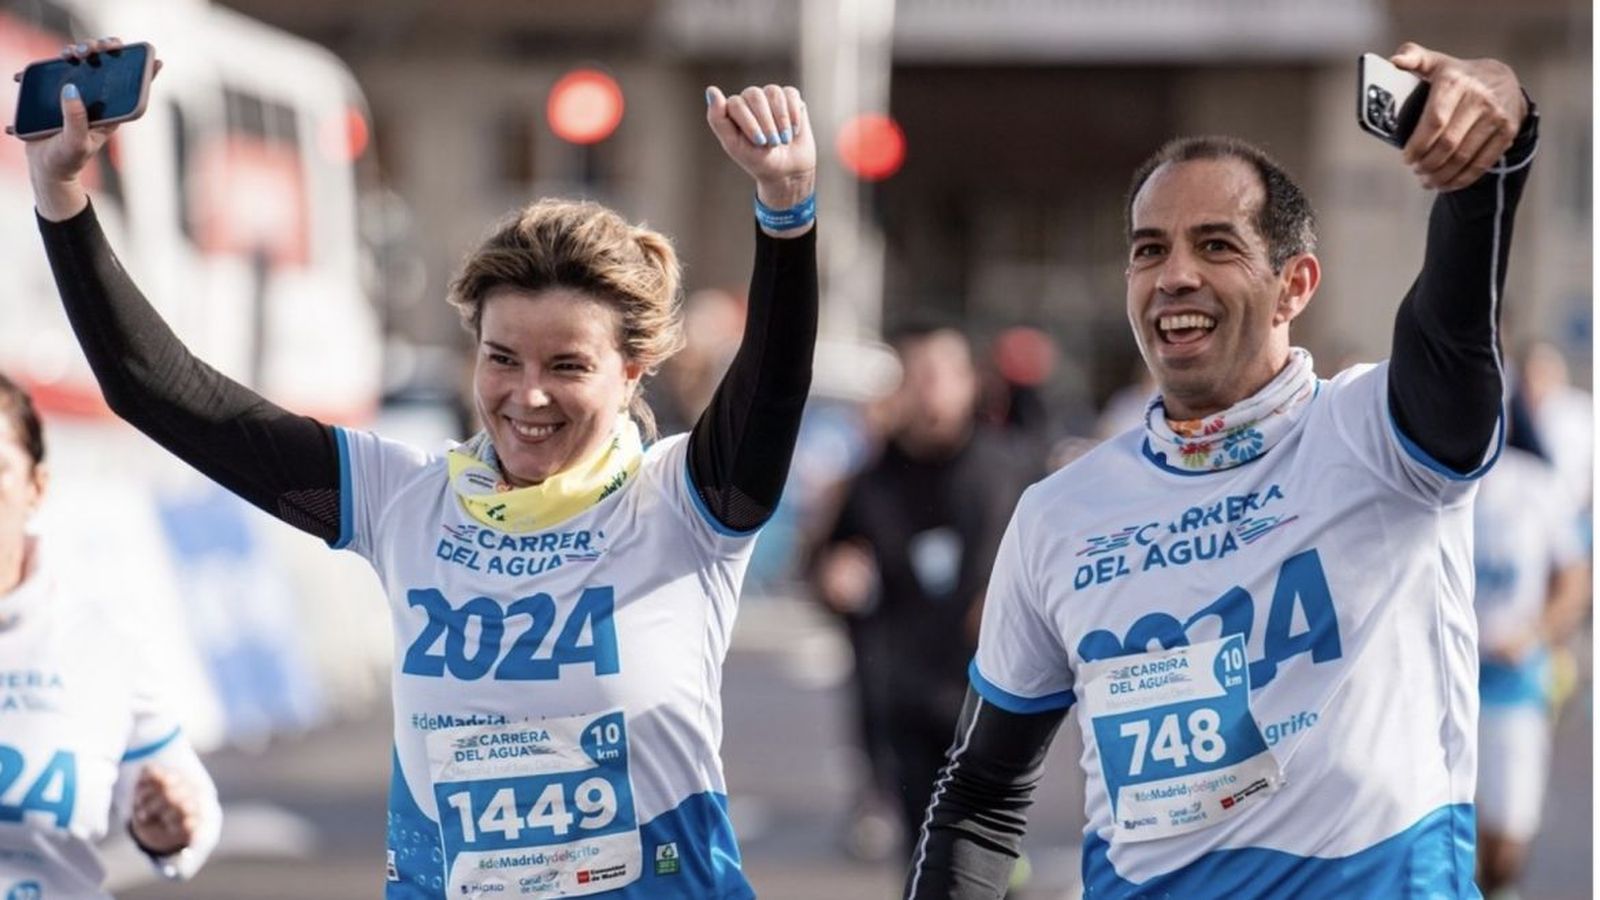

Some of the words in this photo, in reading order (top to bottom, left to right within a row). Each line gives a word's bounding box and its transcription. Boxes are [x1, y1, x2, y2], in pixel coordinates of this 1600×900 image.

[477, 530, 605, 551] CARRER
[437, 539, 480, 571] DEL
[487, 554, 563, 576] AGUA
[1074, 555, 1130, 590] DEL
[1142, 530, 1239, 572] AGUA
[402, 585, 620, 681] 2024
[1130, 657, 1189, 676] CARRERA
[1221, 647, 1243, 672] 10
[1110, 682, 1135, 695] DEL
[1138, 677, 1171, 690] AGUA
[1224, 675, 1242, 687] km
[479, 730, 550, 746] CARRERA
[591, 723, 620, 746] 10
[1119, 707, 1227, 776] 748
[455, 750, 483, 762] DEL
[488, 745, 531, 760] AGUA
[597, 748, 619, 760] km
[448, 777, 618, 843] 1449
